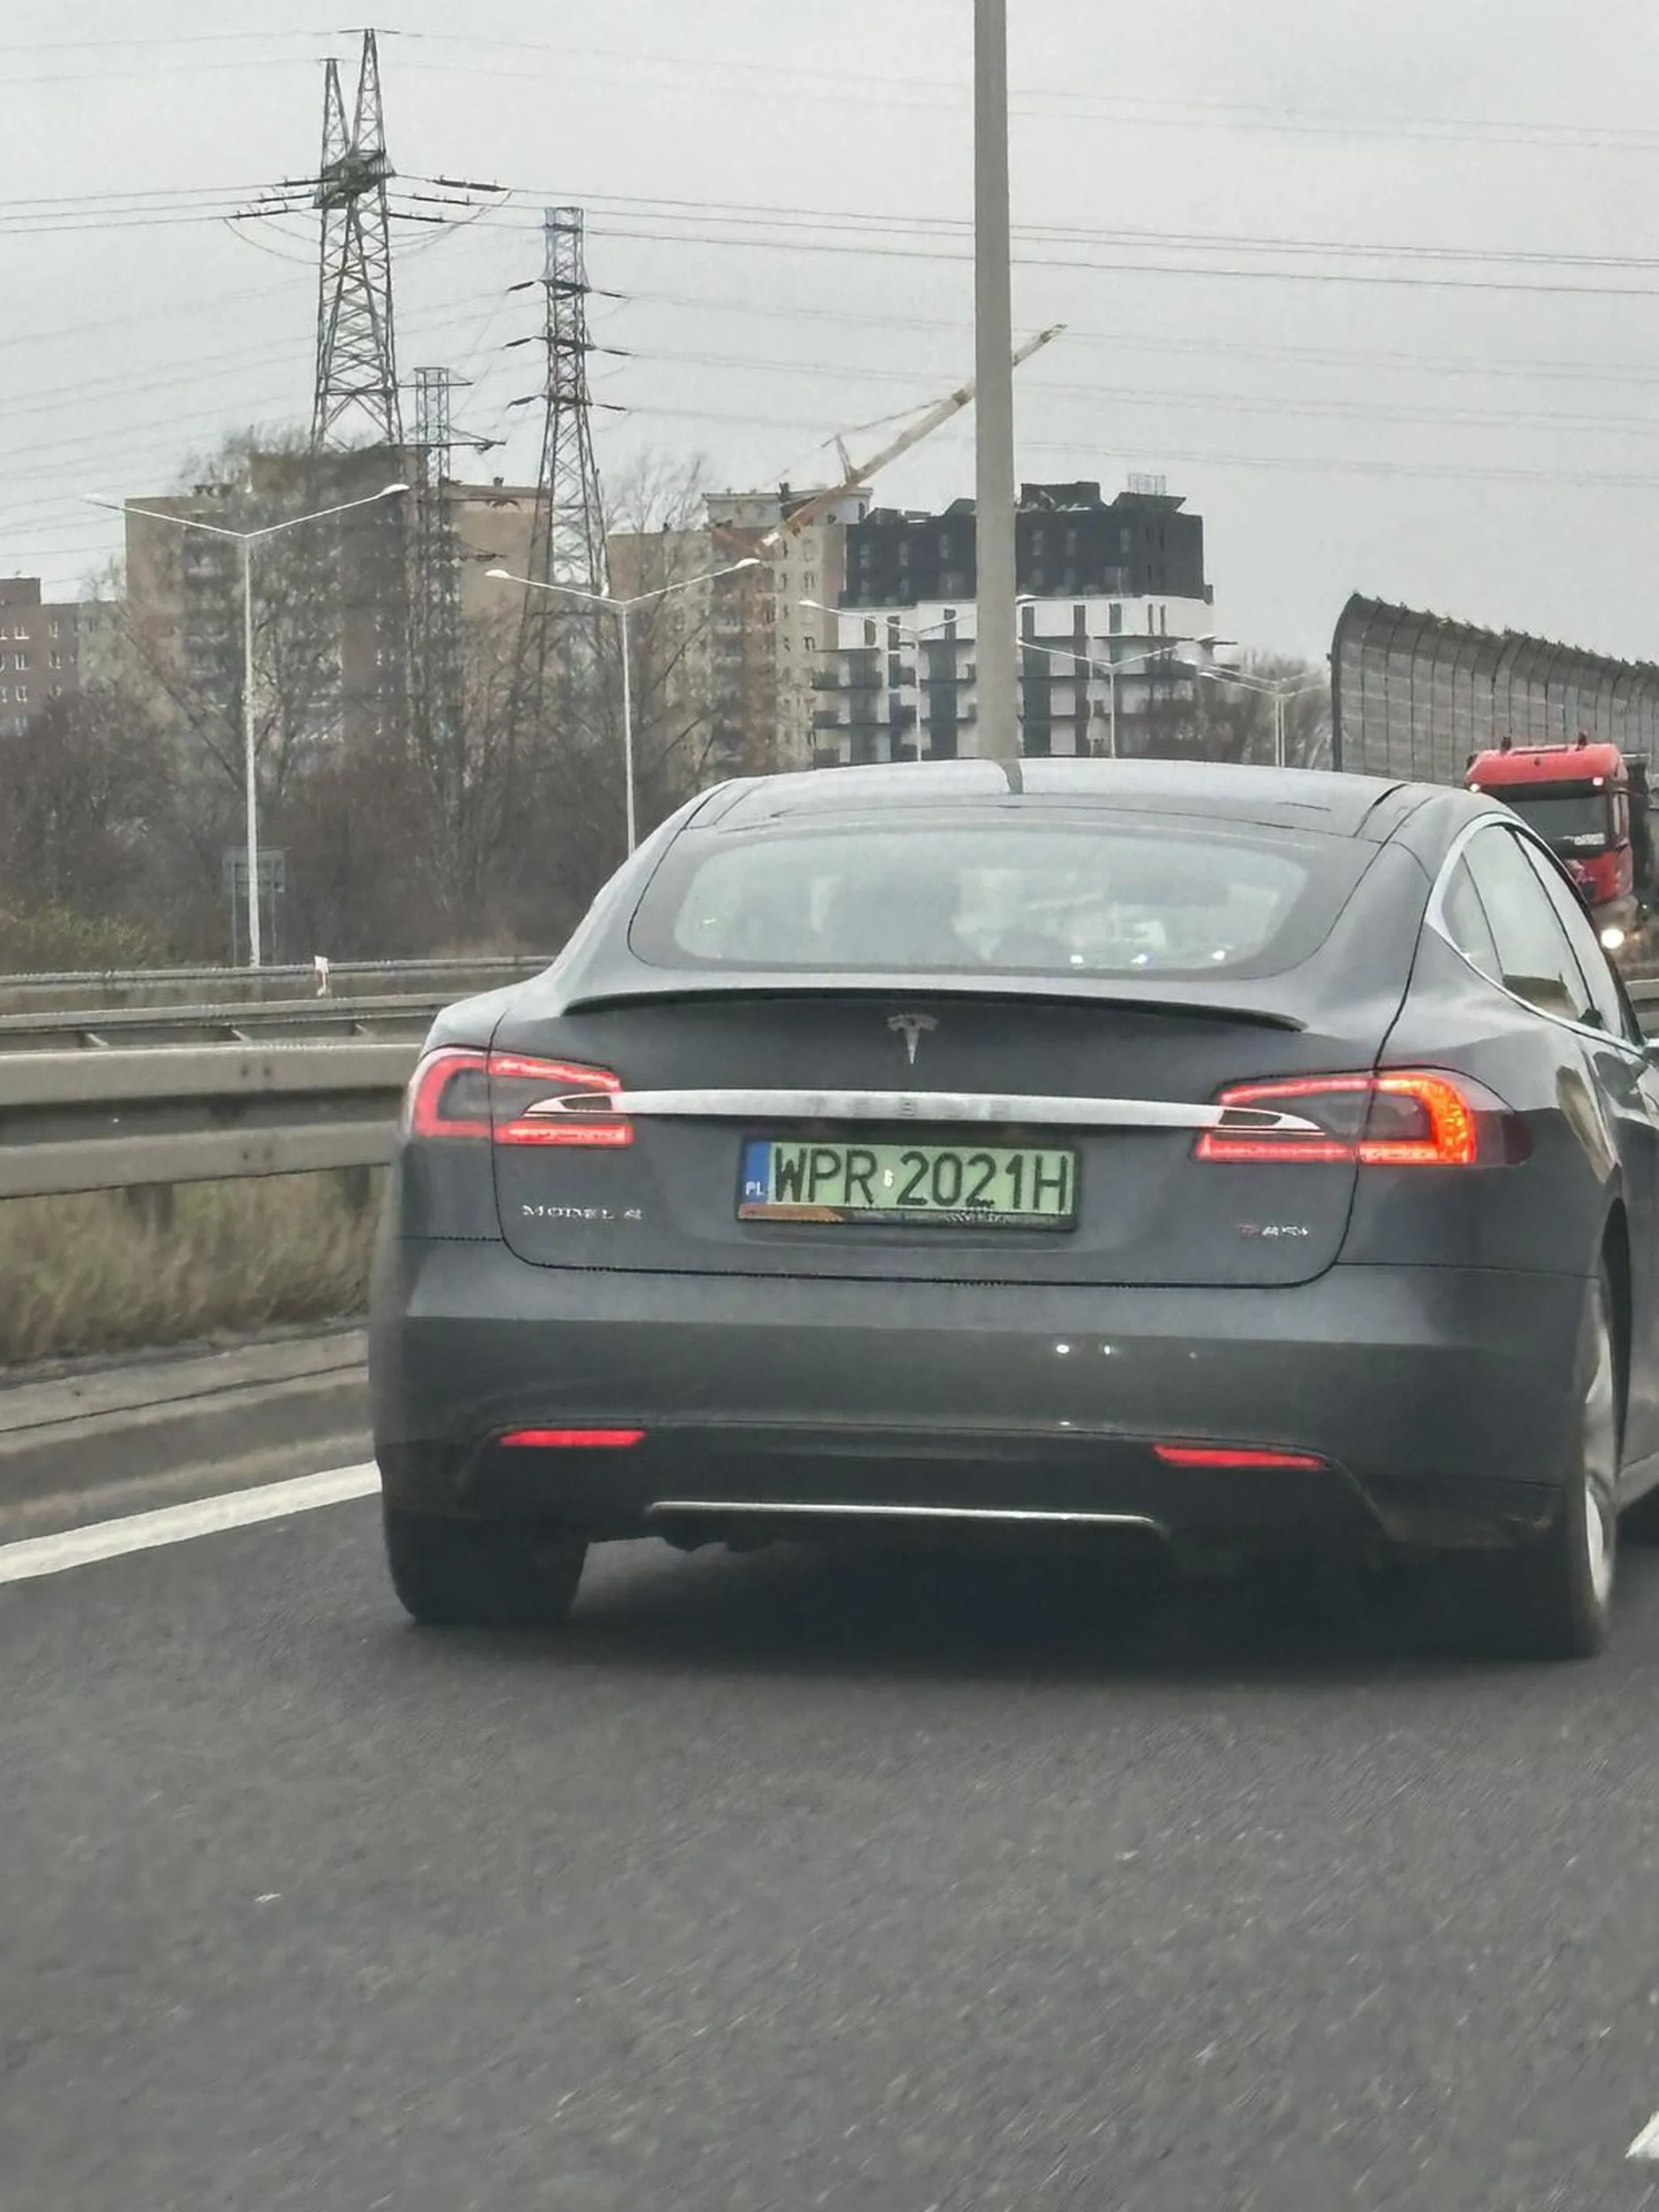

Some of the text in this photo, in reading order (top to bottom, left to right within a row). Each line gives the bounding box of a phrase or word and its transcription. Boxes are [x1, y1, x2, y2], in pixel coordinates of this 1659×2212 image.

[745, 1180, 764, 1195] PL
[774, 1146, 1067, 1212] WPR 2021H
